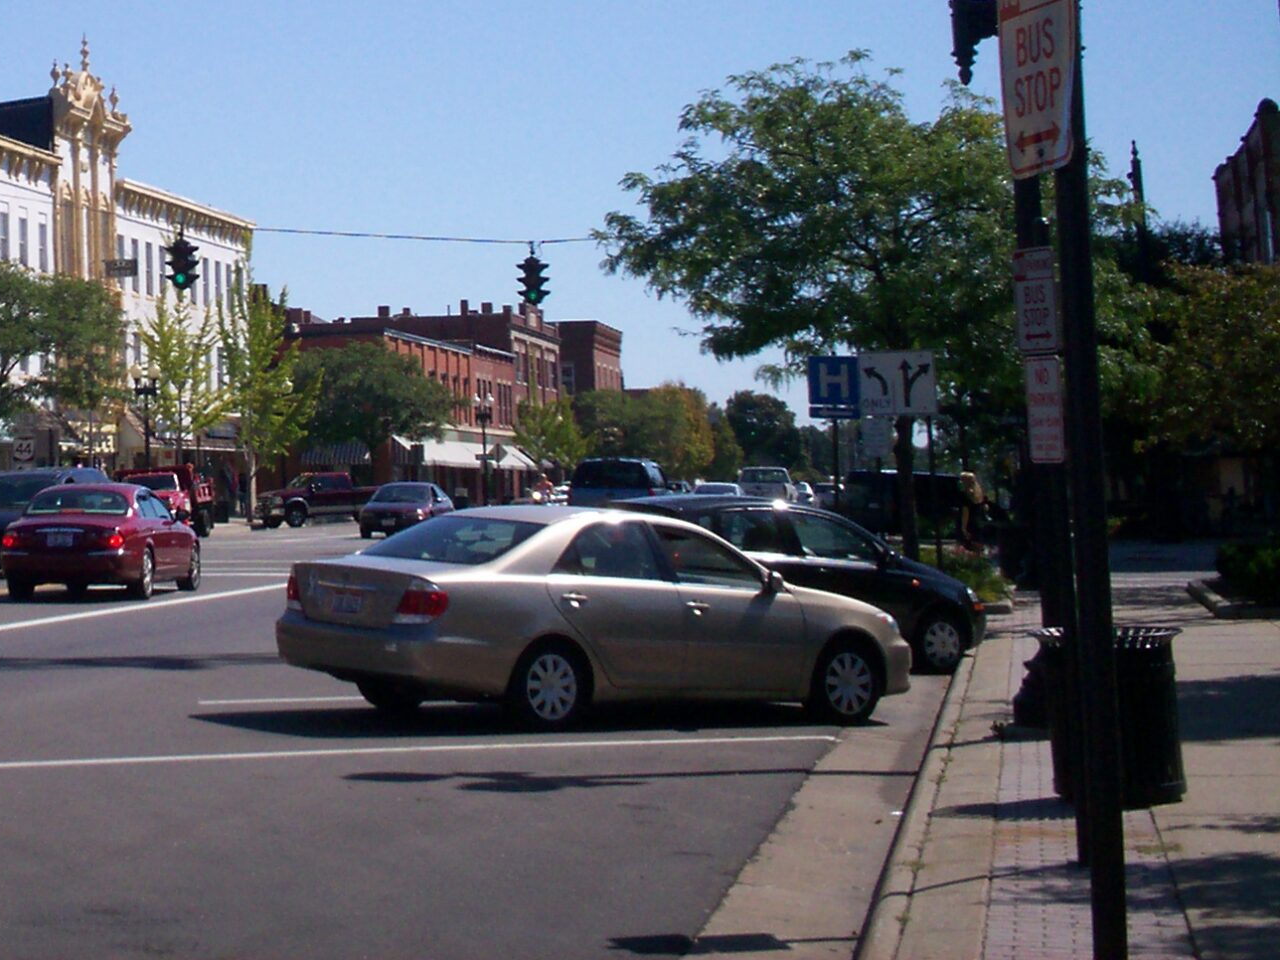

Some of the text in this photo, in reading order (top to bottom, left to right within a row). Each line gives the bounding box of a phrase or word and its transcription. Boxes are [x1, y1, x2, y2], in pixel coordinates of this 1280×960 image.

[1016, 17, 1055, 67] BUS
[1015, 66, 1061, 118] STOP
[1023, 284, 1046, 304] BUS
[1023, 307, 1050, 327] STOP
[818, 363, 849, 398] H
[1034, 367, 1049, 385] NO
[863, 398, 891, 409] ONLY
[16, 442, 32, 455] 44
